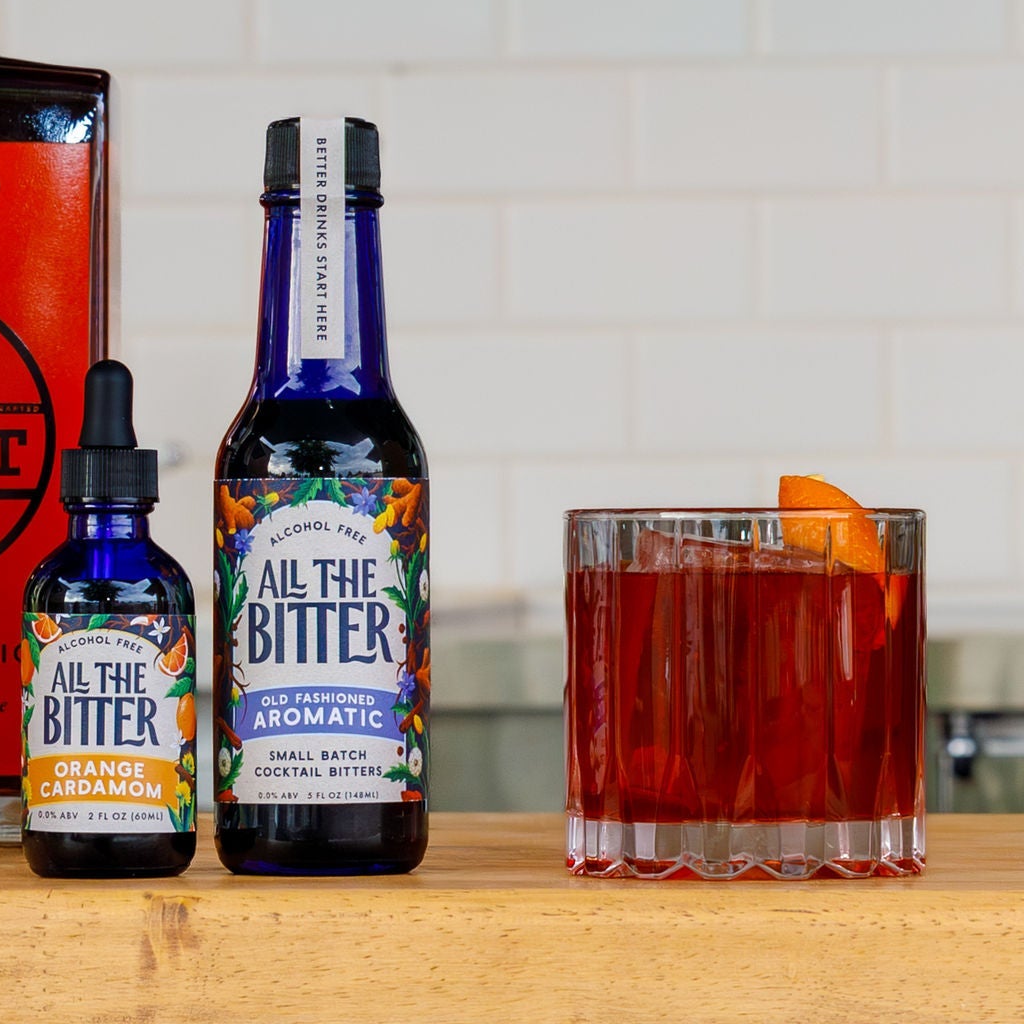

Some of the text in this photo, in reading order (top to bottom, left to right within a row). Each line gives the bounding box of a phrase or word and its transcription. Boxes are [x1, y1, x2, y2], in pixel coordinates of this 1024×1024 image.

[316, 137, 327, 341] BETTER DRINKS START HERE
[270, 521, 367, 547] ALCOHOL FREE
[257, 559, 376, 599] ALL THE
[248, 602, 394, 664] BITTER
[58, 635, 143, 654] ALCOHOL FREE
[51, 661, 147, 694] ALL THE
[261, 693, 375, 707] OLD FASHIONED
[44, 696, 160, 747] BITTER
[253, 707, 384, 730] AROMATIC
[269, 750, 367, 761] SMALL BATCH
[54, 760, 145, 778] ORANGE
[255, 766, 382, 777] COCKTAIL BITTERS
[40, 780, 162, 799] CARDAMOM
[258, 791, 379, 800] 0.0% ABV 5 FL OZ (148ML)
[38, 811, 163, 822] 0.0% ABV 2 FL OZ (60ML)
